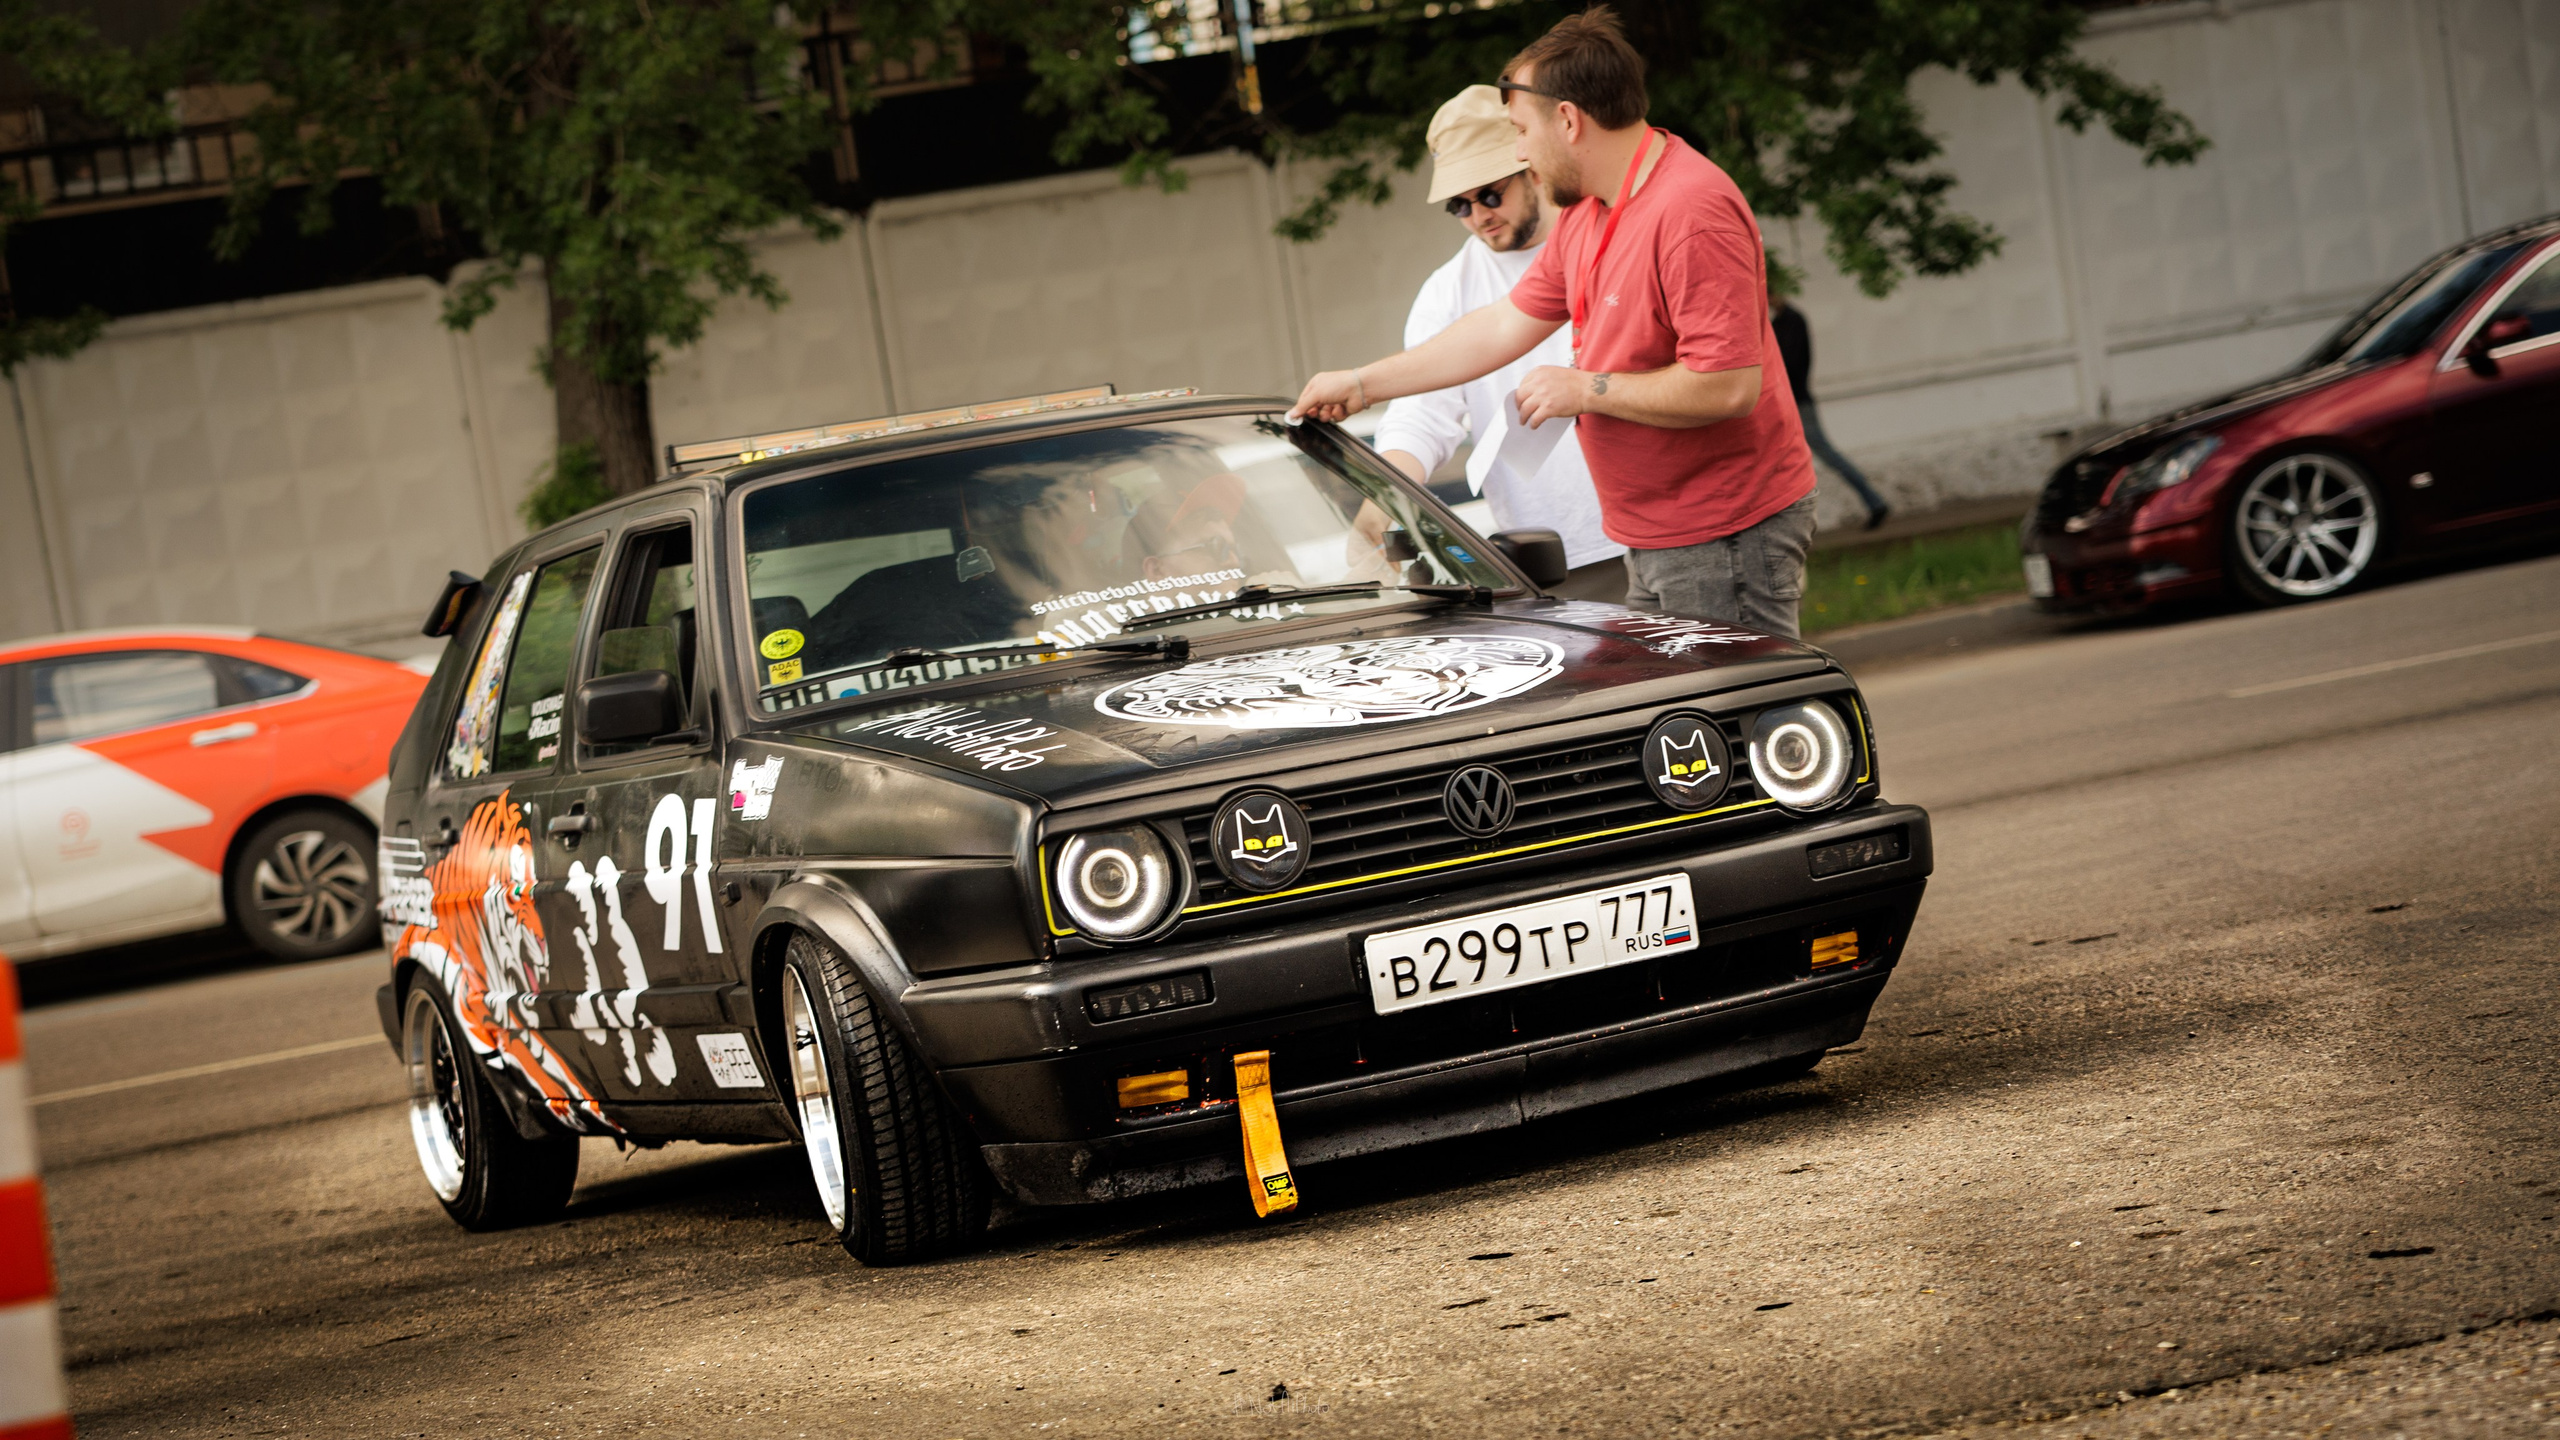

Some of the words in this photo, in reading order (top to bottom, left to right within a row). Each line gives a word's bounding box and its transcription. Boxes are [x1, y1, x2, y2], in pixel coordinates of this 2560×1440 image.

[1030, 567, 1247, 616] suicidevolkswagen
[771, 659, 800, 673] ADAC
[528, 712, 561, 741] Racin
[644, 793, 723, 953] 91
[1600, 885, 1672, 939] 777
[1625, 933, 1663, 953] RUS
[1266, 1177, 1289, 1190] OMP
